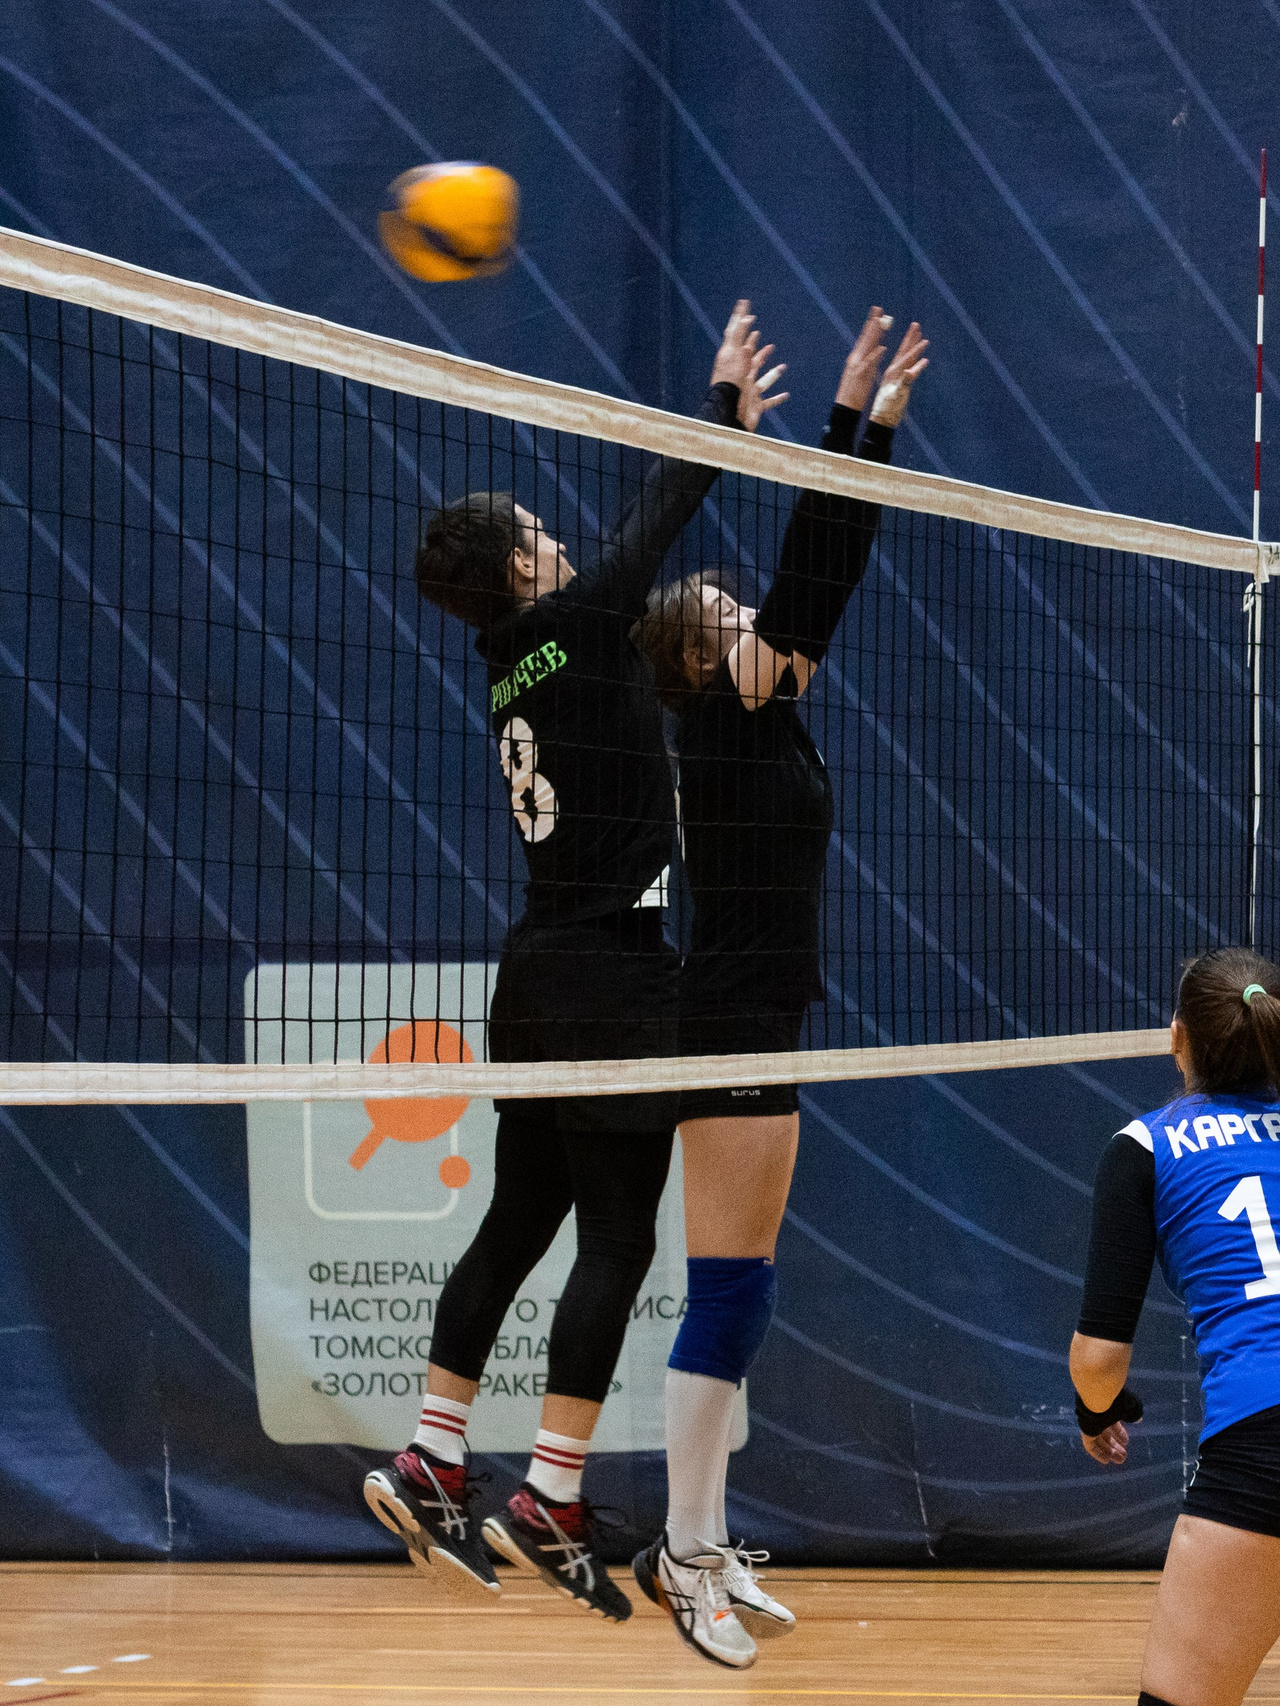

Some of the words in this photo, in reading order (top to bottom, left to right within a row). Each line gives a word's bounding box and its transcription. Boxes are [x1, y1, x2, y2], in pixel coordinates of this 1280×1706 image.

[500, 717, 559, 843] 8
[308, 1261, 456, 1287] ФЕДЕРАЦ
[310, 1335, 433, 1359] ТОМСКО
[311, 1373, 427, 1396] «ЗОЛОТ
